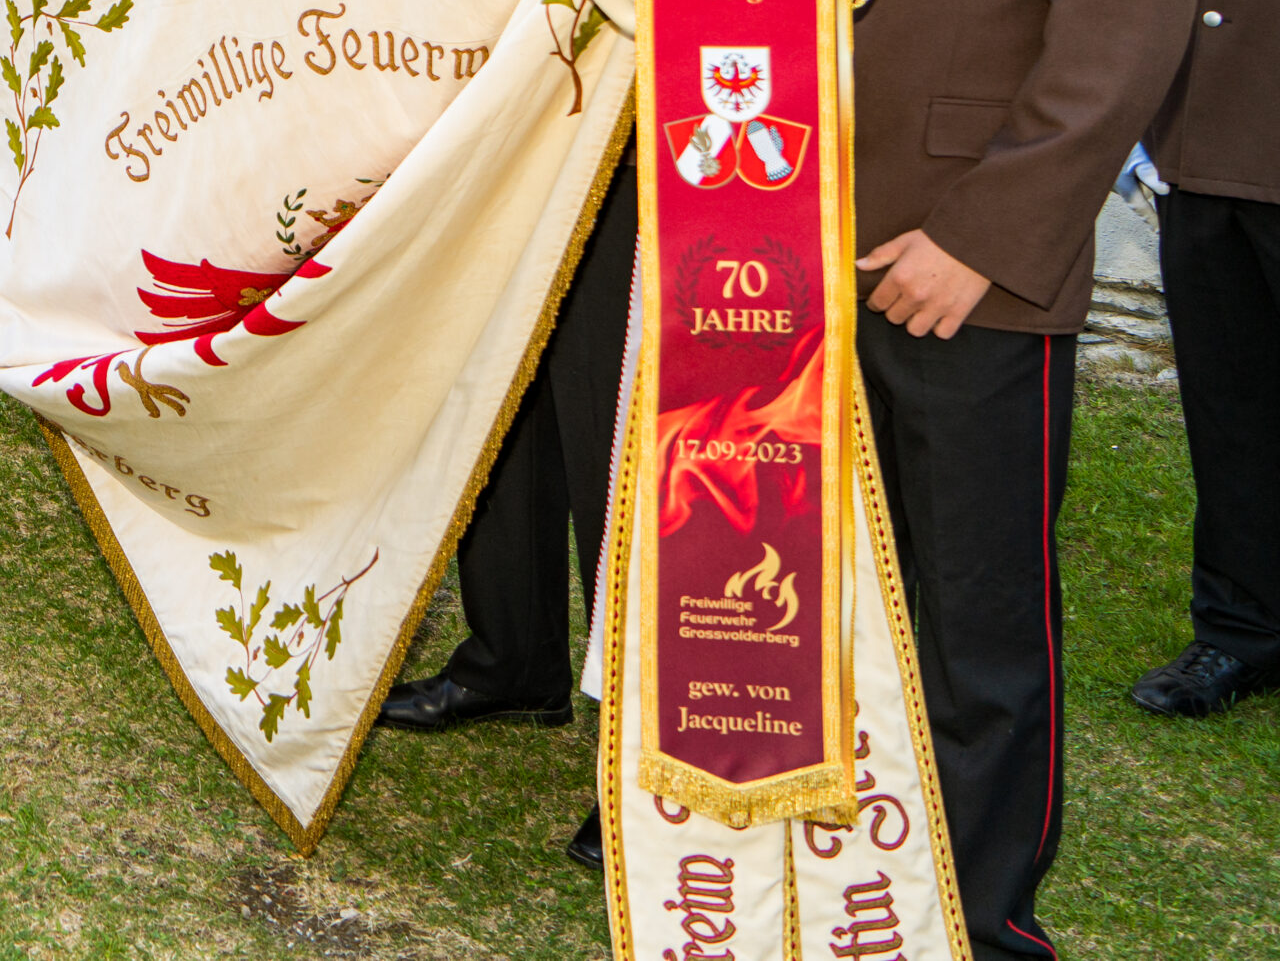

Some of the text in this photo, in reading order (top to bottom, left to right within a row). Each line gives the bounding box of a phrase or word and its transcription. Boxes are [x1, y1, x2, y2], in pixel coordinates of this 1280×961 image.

[105, 35, 293, 183] Freiwillige
[715, 260, 769, 299] 70
[690, 307, 794, 335] JAHRE
[676, 439, 803, 464] 17.09.2023
[680, 596, 754, 613] Freiwillige
[680, 611, 757, 627] Feuerwehr
[678, 626, 800, 647] Grossvolderberg
[688, 681, 791, 701] gew. von
[677, 706, 803, 736] Jacqueline
